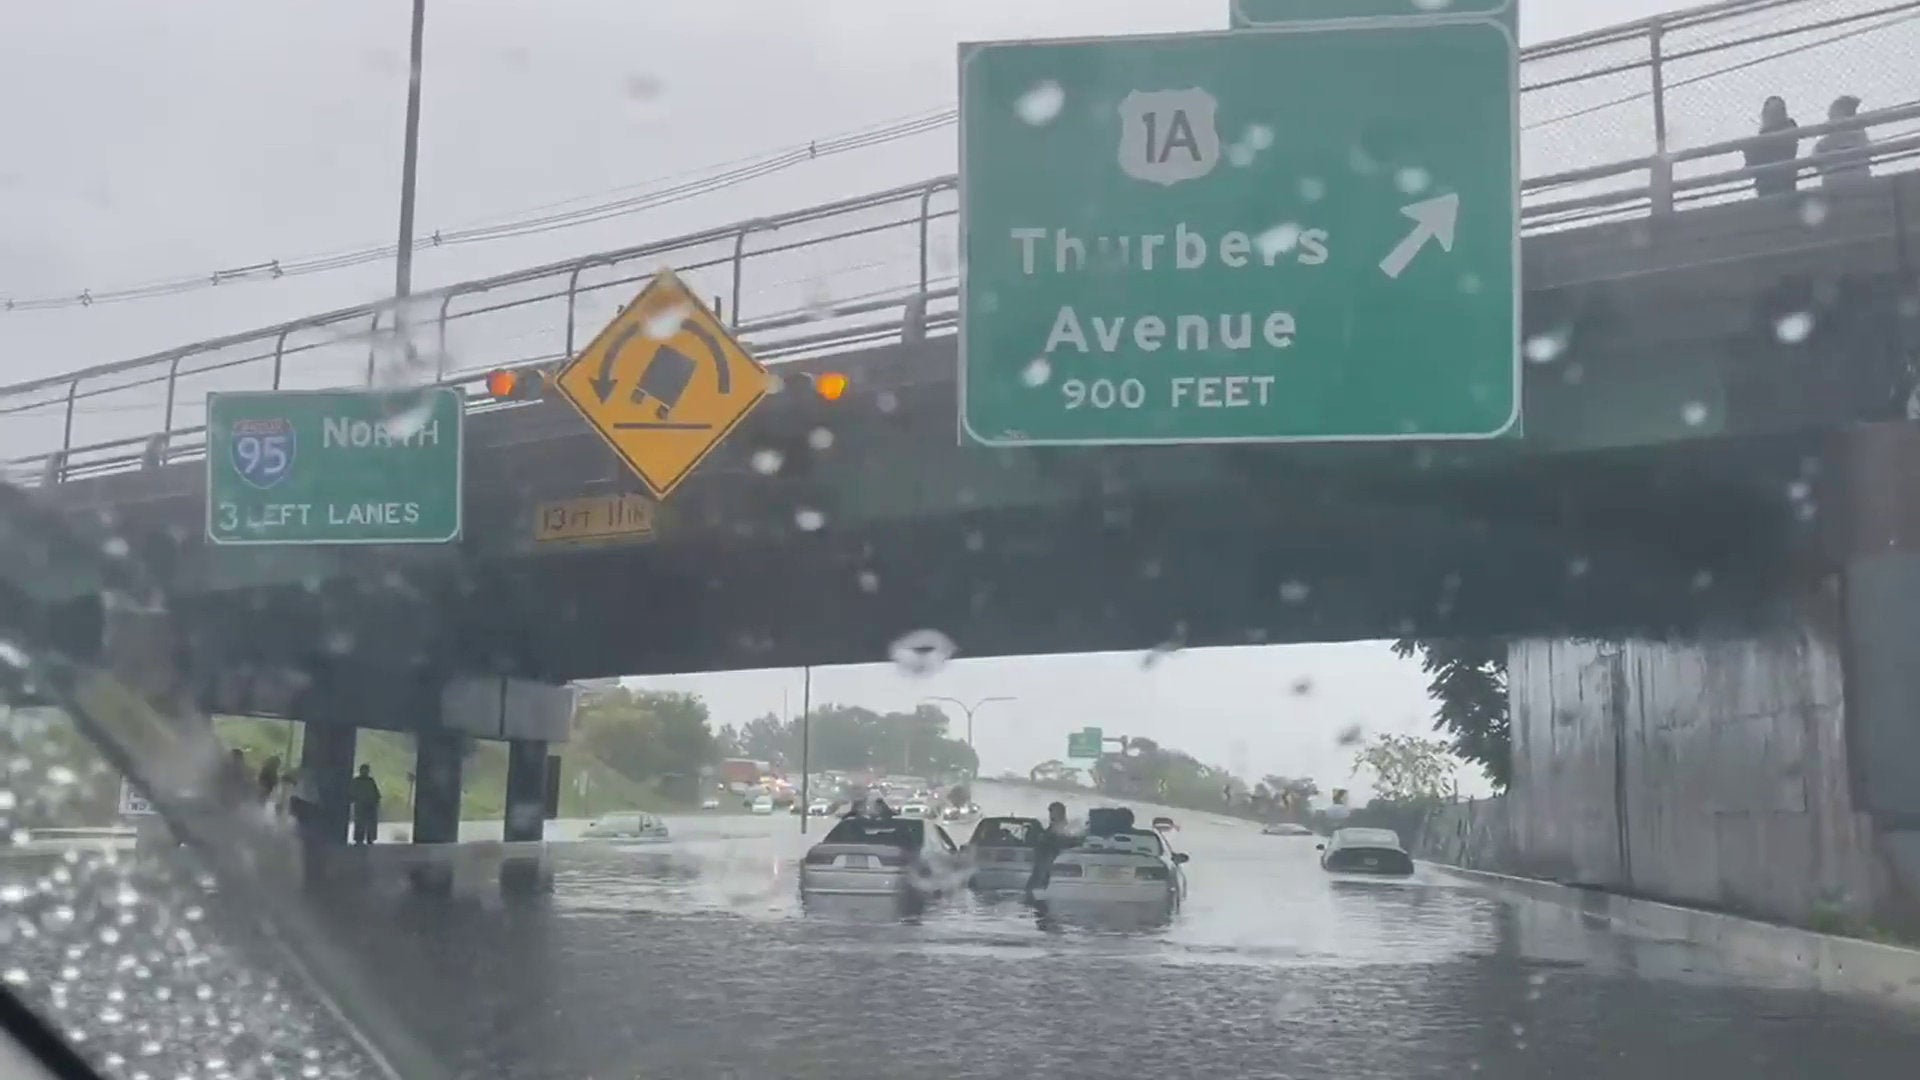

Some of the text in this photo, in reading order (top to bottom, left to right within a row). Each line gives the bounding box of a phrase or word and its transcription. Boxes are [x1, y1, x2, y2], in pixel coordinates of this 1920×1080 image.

[1141, 108, 1202, 164] 1A
[1044, 305, 1297, 352] Avenue
[1062, 376, 1275, 409] 900 FEET
[238, 436, 286, 473] 95
[219, 502, 420, 530] 3 LEFT LANES
